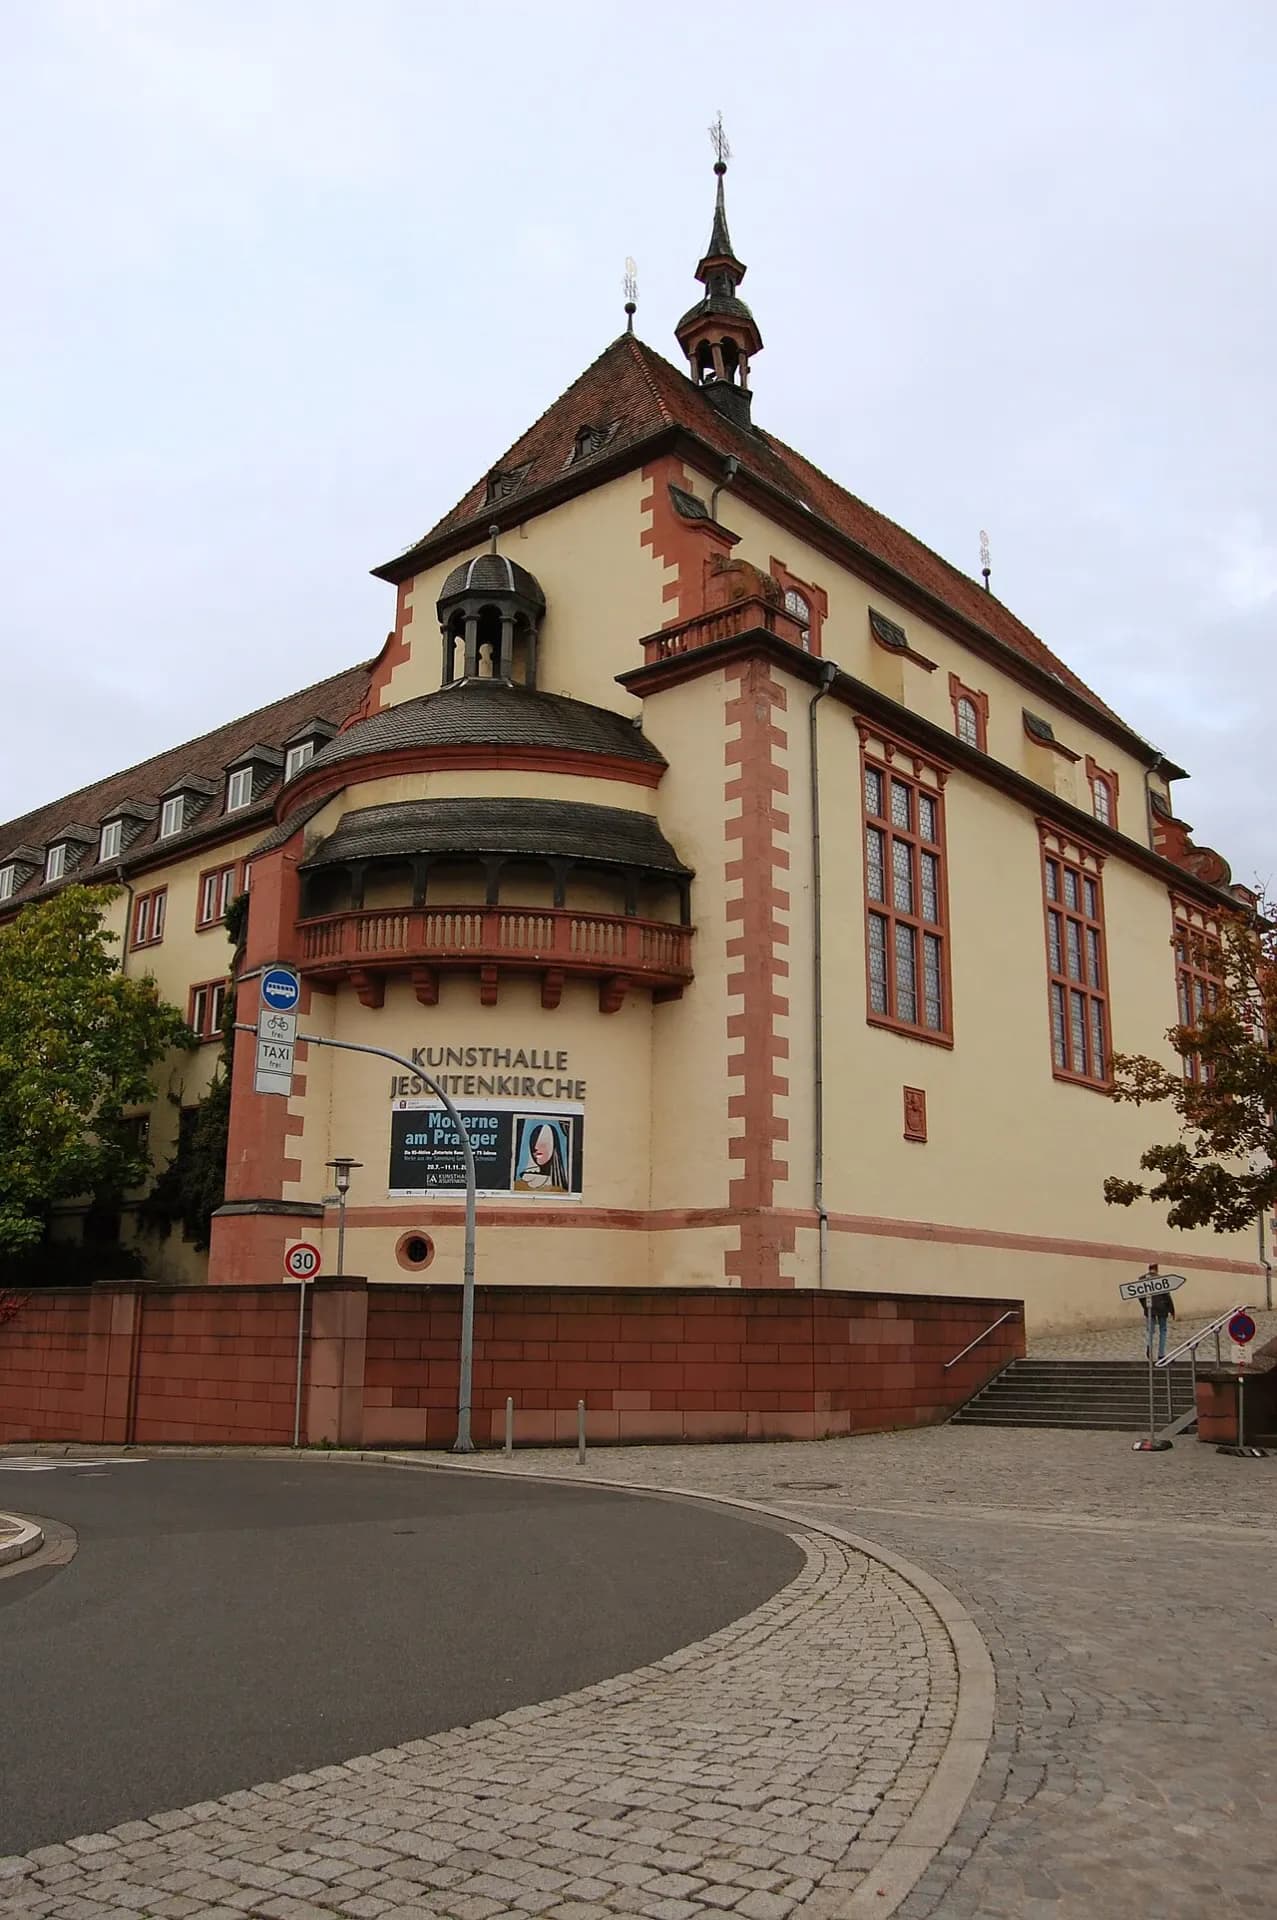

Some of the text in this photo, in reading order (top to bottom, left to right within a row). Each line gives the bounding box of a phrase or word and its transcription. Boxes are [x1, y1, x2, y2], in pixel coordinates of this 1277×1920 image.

[263, 1045, 290, 1060] TAXI
[411, 1047, 568, 1070] KUNSTHALLE
[390, 1075, 586, 1099] JESUITENKIRCHE
[405, 1129, 498, 1150] am Prager
[292, 1253, 314, 1269] 30
[1127, 1278, 1170, 1297] Schloß
